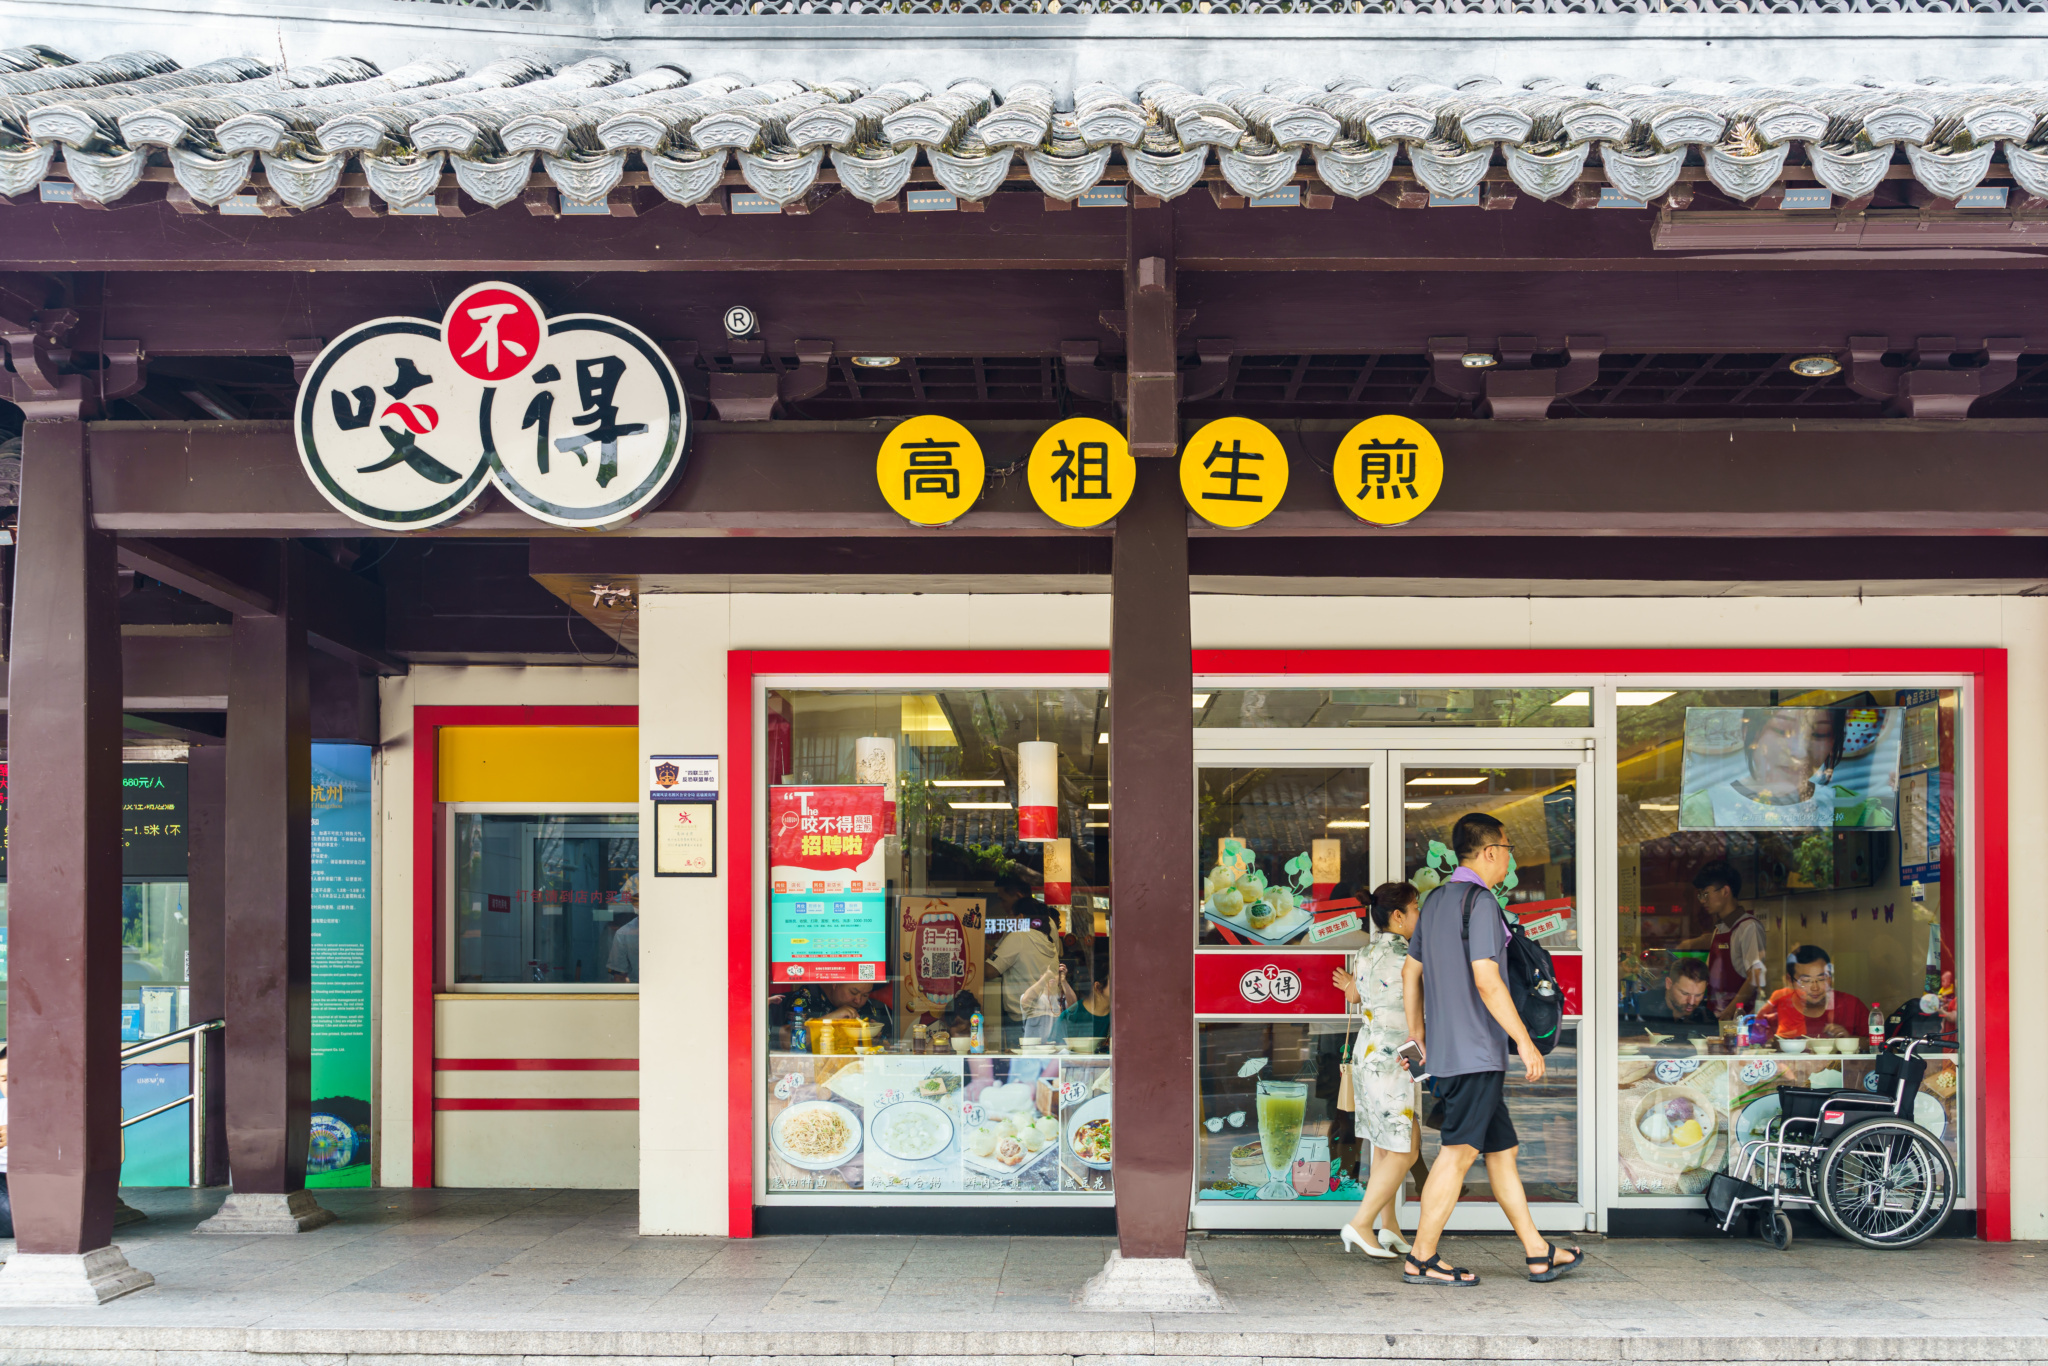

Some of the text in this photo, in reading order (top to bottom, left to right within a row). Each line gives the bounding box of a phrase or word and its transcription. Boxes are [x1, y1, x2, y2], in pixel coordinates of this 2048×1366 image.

[900, 438, 1419, 503] 高祖生煎
[311, 784, 343, 803] 杭州
[801, 816, 854, 834] 咬不得
[801, 834, 863, 856] 招聘啦
[515, 888, 633, 904] 打包请到店内买单
[924, 930, 957, 944] 扫一扫
[1318, 920, 1350, 937] 荠菜生煎
[952, 960, 964, 976] 吃
[1244, 968, 1296, 998] 咬不得
[1064, 1177, 1106, 1190] 咸豆花
